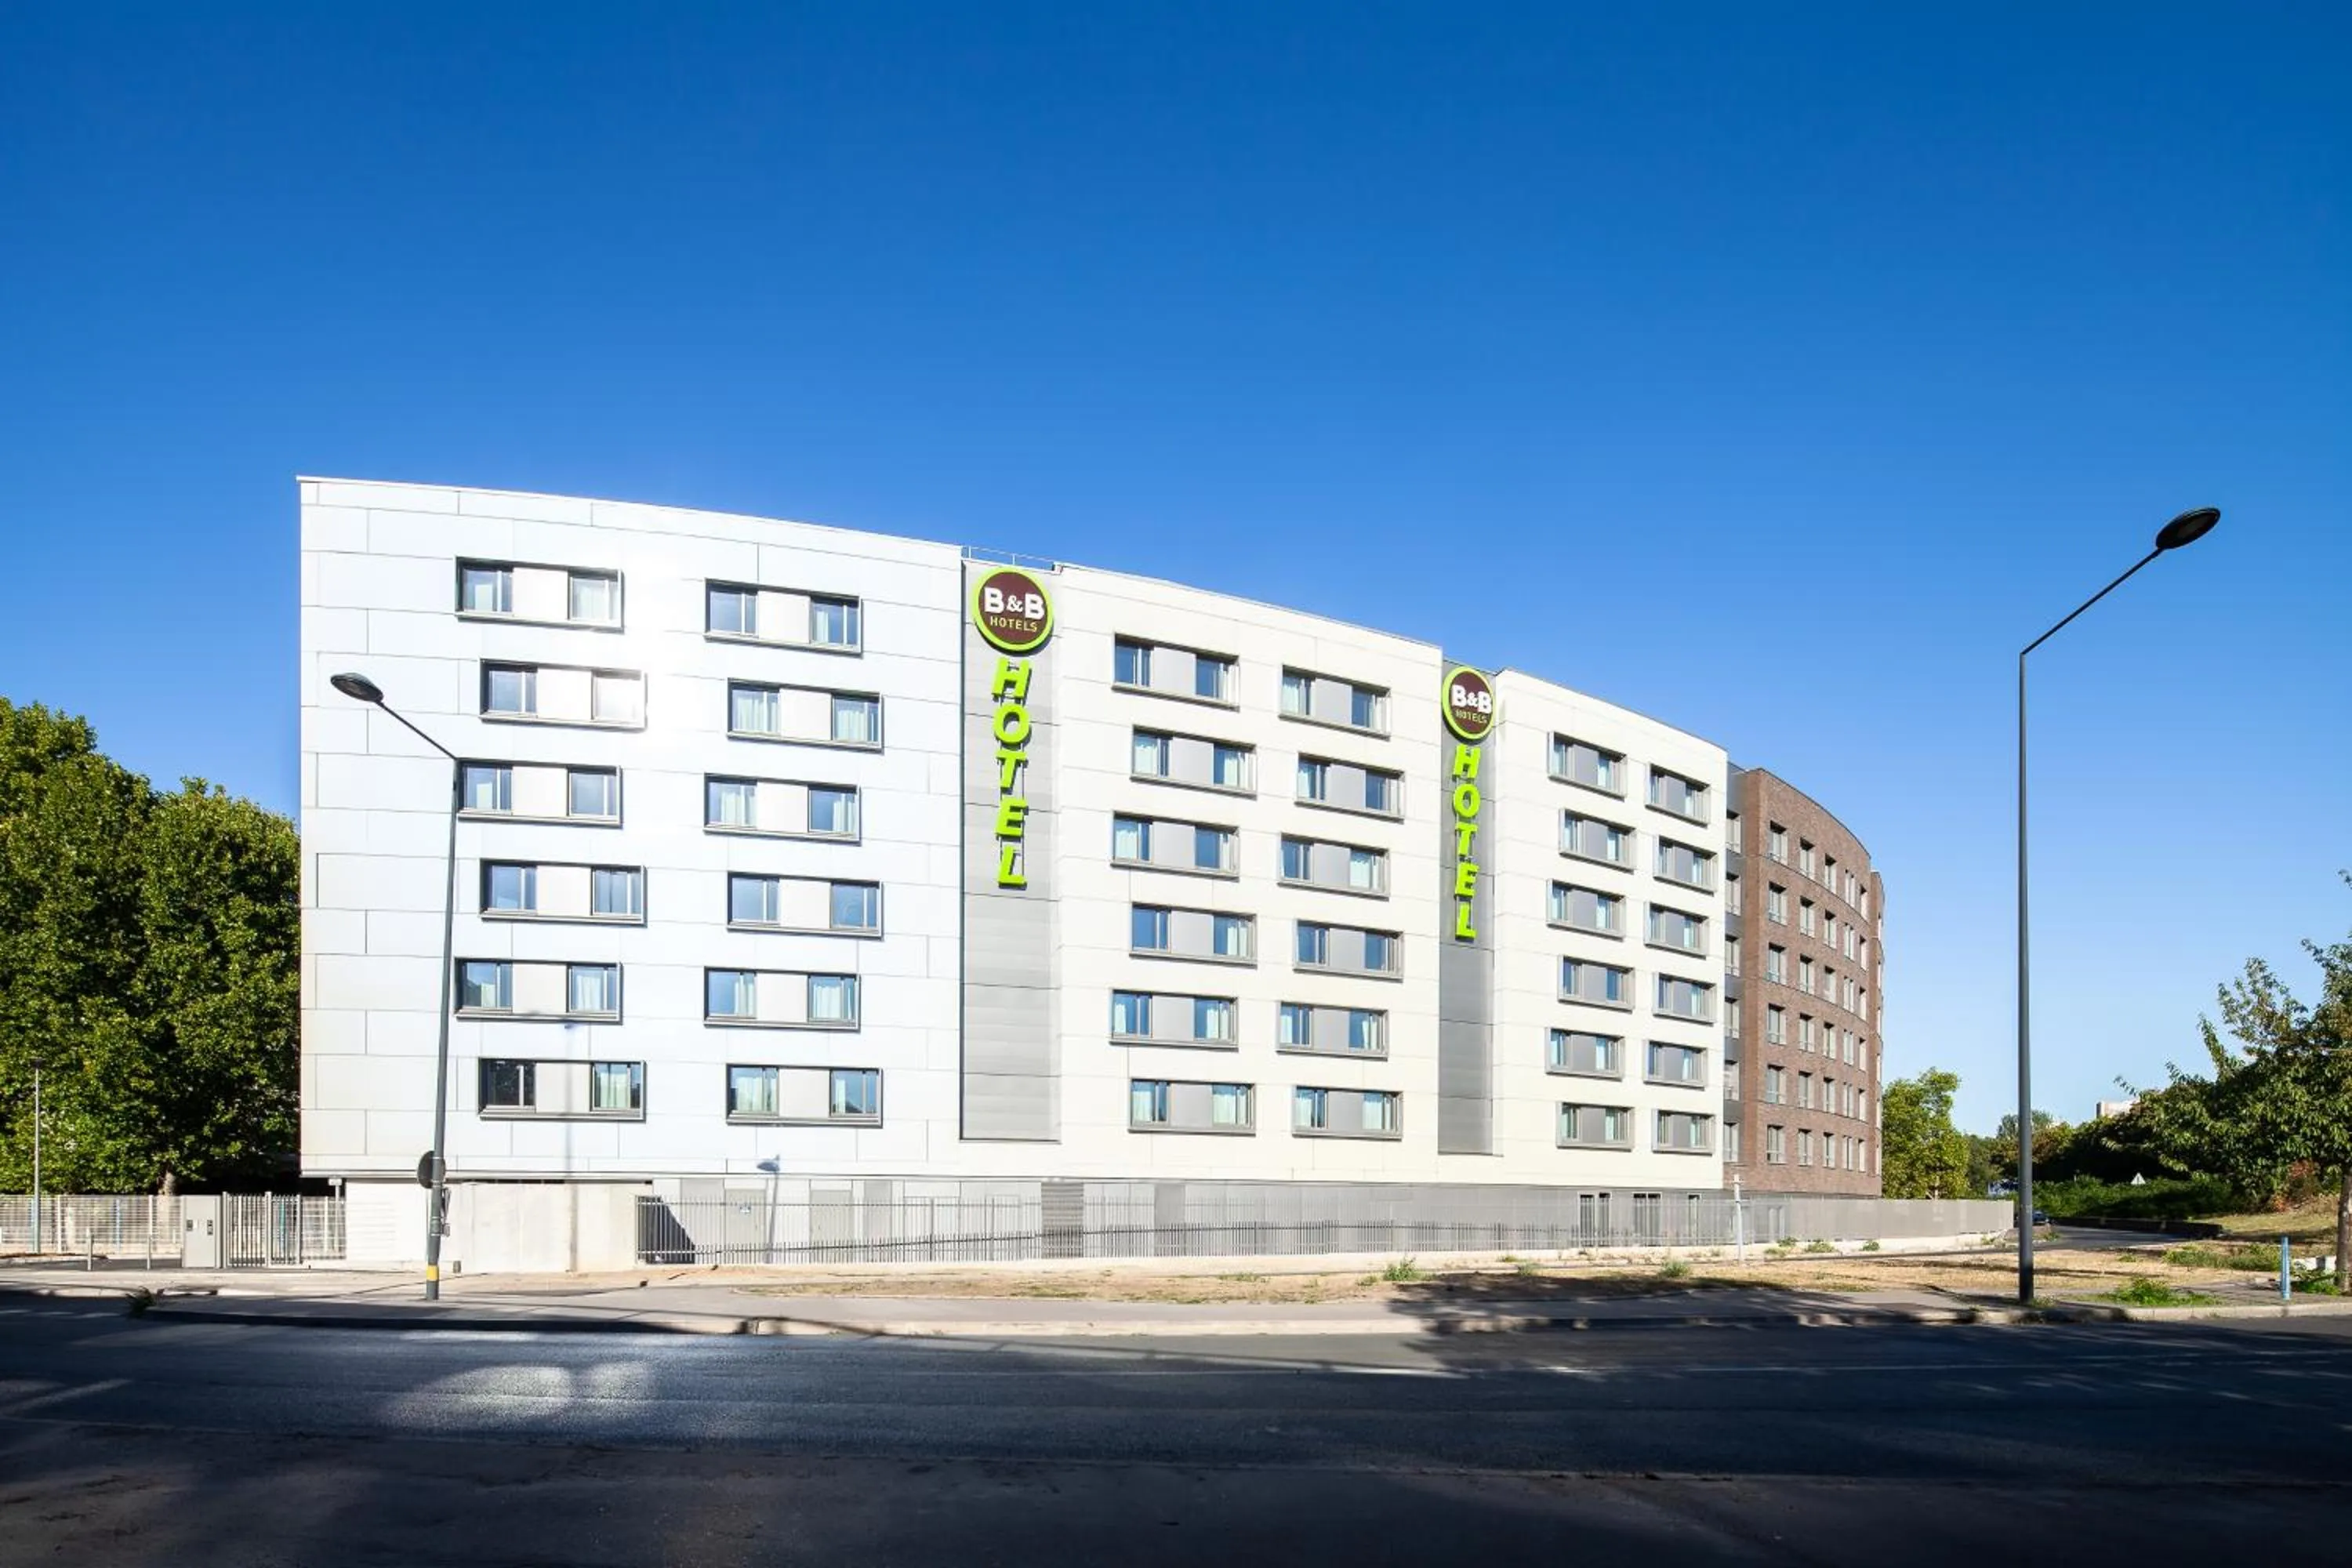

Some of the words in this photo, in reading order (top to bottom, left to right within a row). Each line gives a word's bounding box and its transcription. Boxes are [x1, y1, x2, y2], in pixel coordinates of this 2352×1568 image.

[984, 587, 1044, 619] B&B
[990, 616, 1037, 632] HOTELS
[1451, 684, 1492, 713] B&B
[1456, 710, 1487, 724] HOTELS
[993, 657, 1031, 885] HOTEL
[1453, 745, 1481, 938] HOTEL
